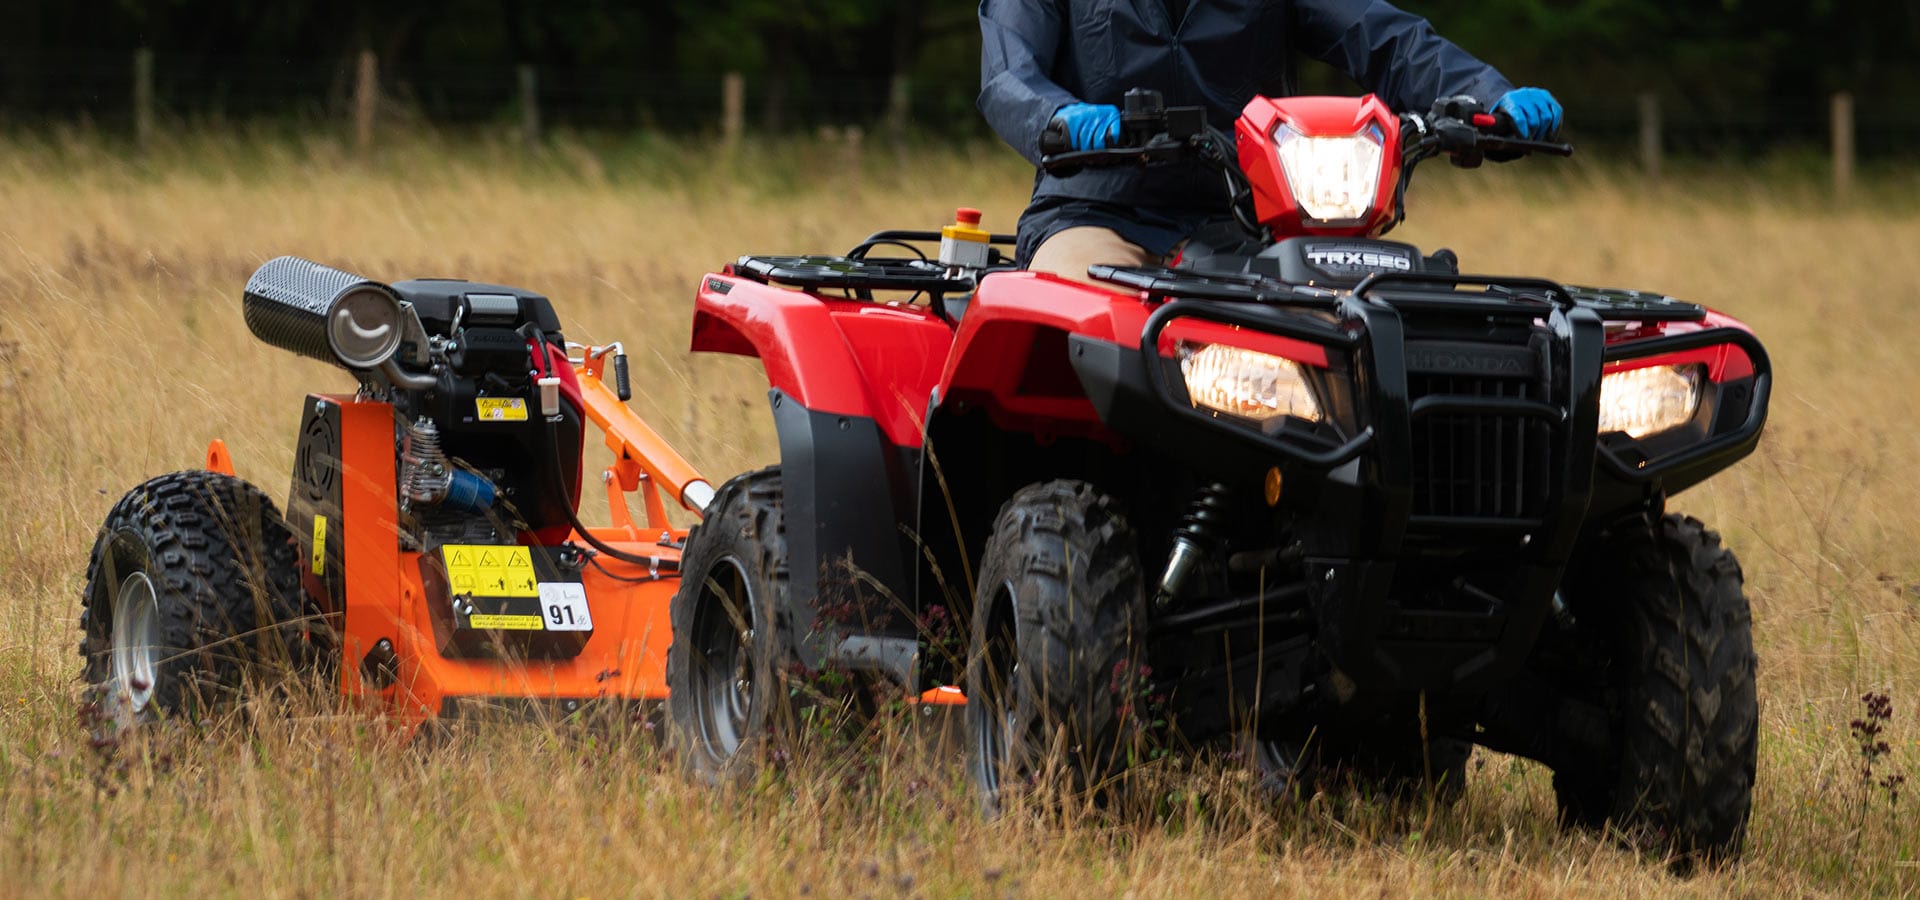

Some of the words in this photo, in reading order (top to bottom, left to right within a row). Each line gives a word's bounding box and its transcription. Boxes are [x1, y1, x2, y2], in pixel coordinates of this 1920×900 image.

[1307, 252, 1411, 271] TRX520
[1409, 351, 1522, 372] HONDA
[549, 604, 575, 625] 91
